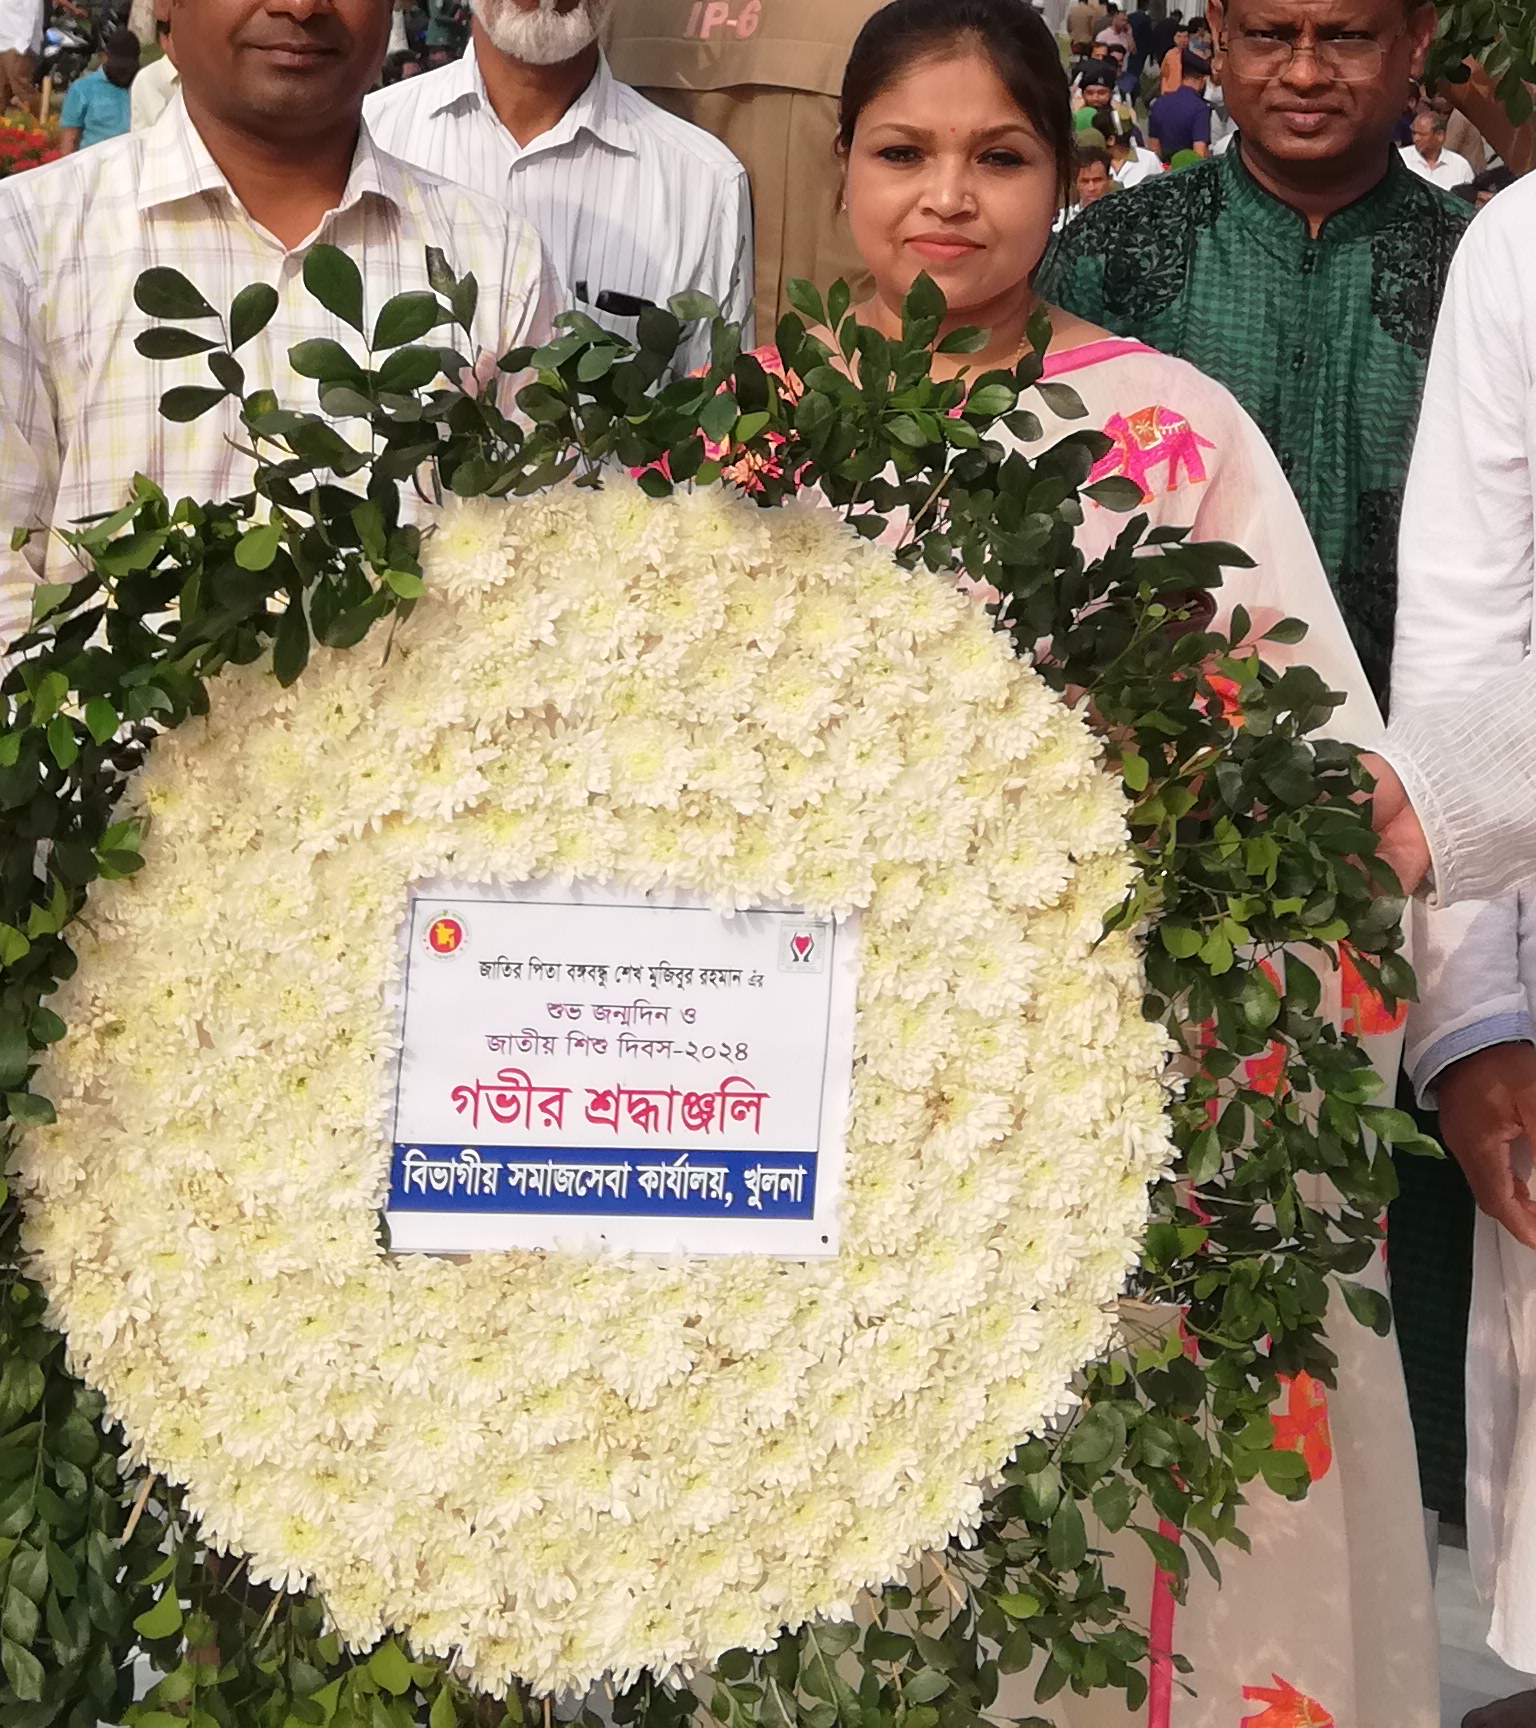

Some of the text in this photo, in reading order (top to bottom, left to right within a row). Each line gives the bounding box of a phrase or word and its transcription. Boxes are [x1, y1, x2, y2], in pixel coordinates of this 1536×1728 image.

[682, 0, 762, 40] IP-6
[478, 955, 524, 980] জাতির
[528, 955, 562, 983] পিতা
[566, 963, 611, 990] বঙ্গবন্ধু
[615, 962, 645, 985] শেখ
[647, 960, 695, 991] মুজিবুর
[698, 968, 743, 989] রহমান
[546, 998, 697, 1026] শুভ জন্মদিন ও
[484, 1027, 749, 1063] জাতীয় শিশু দিবস-২০২৪
[451, 1067, 771, 1136] গভীর শ্রদ্ধাঞ্জলি
[402, 1149, 807, 1210] বিভাগীয় সমাজসেবা কার্যালয়, খুলনা
